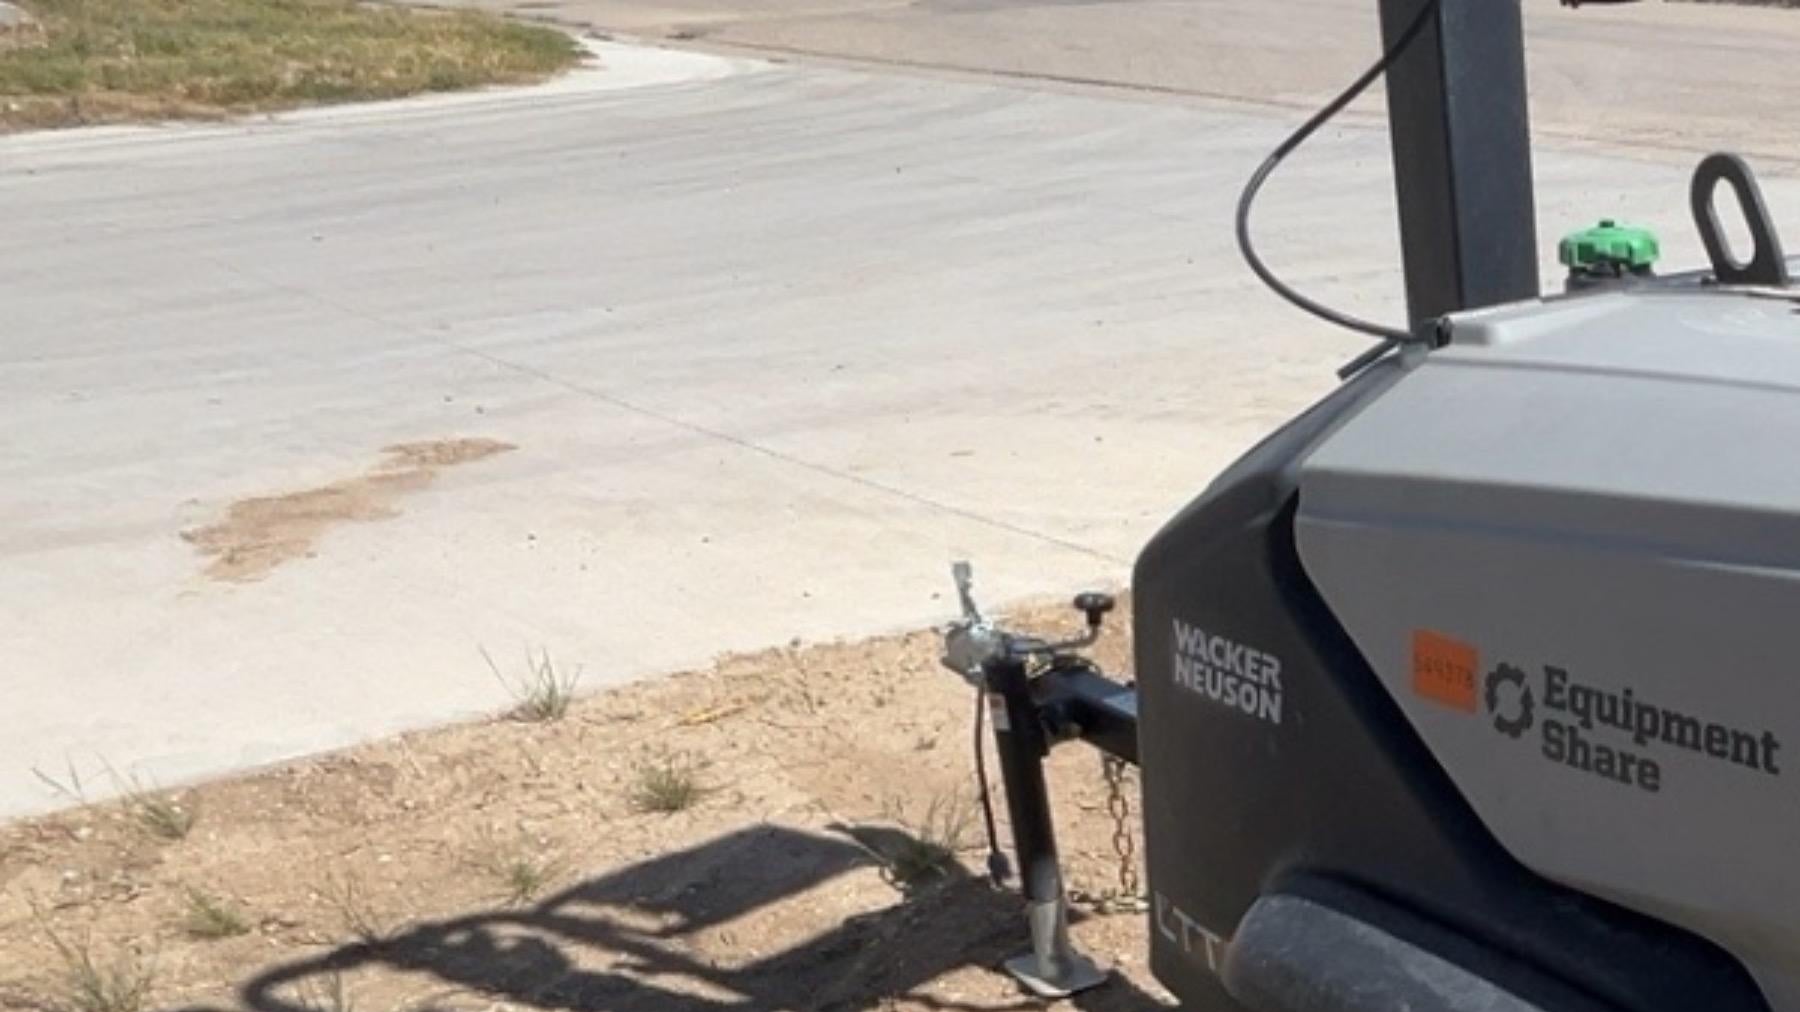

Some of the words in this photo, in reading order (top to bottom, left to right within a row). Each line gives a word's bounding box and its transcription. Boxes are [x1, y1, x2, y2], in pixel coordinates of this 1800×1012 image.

[1173, 617, 1282, 691] WACKER
[1174, 652, 1282, 724] NEUSON
[1541, 717, 1661, 793] Share
[1542, 664, 1780, 775] Equipment
